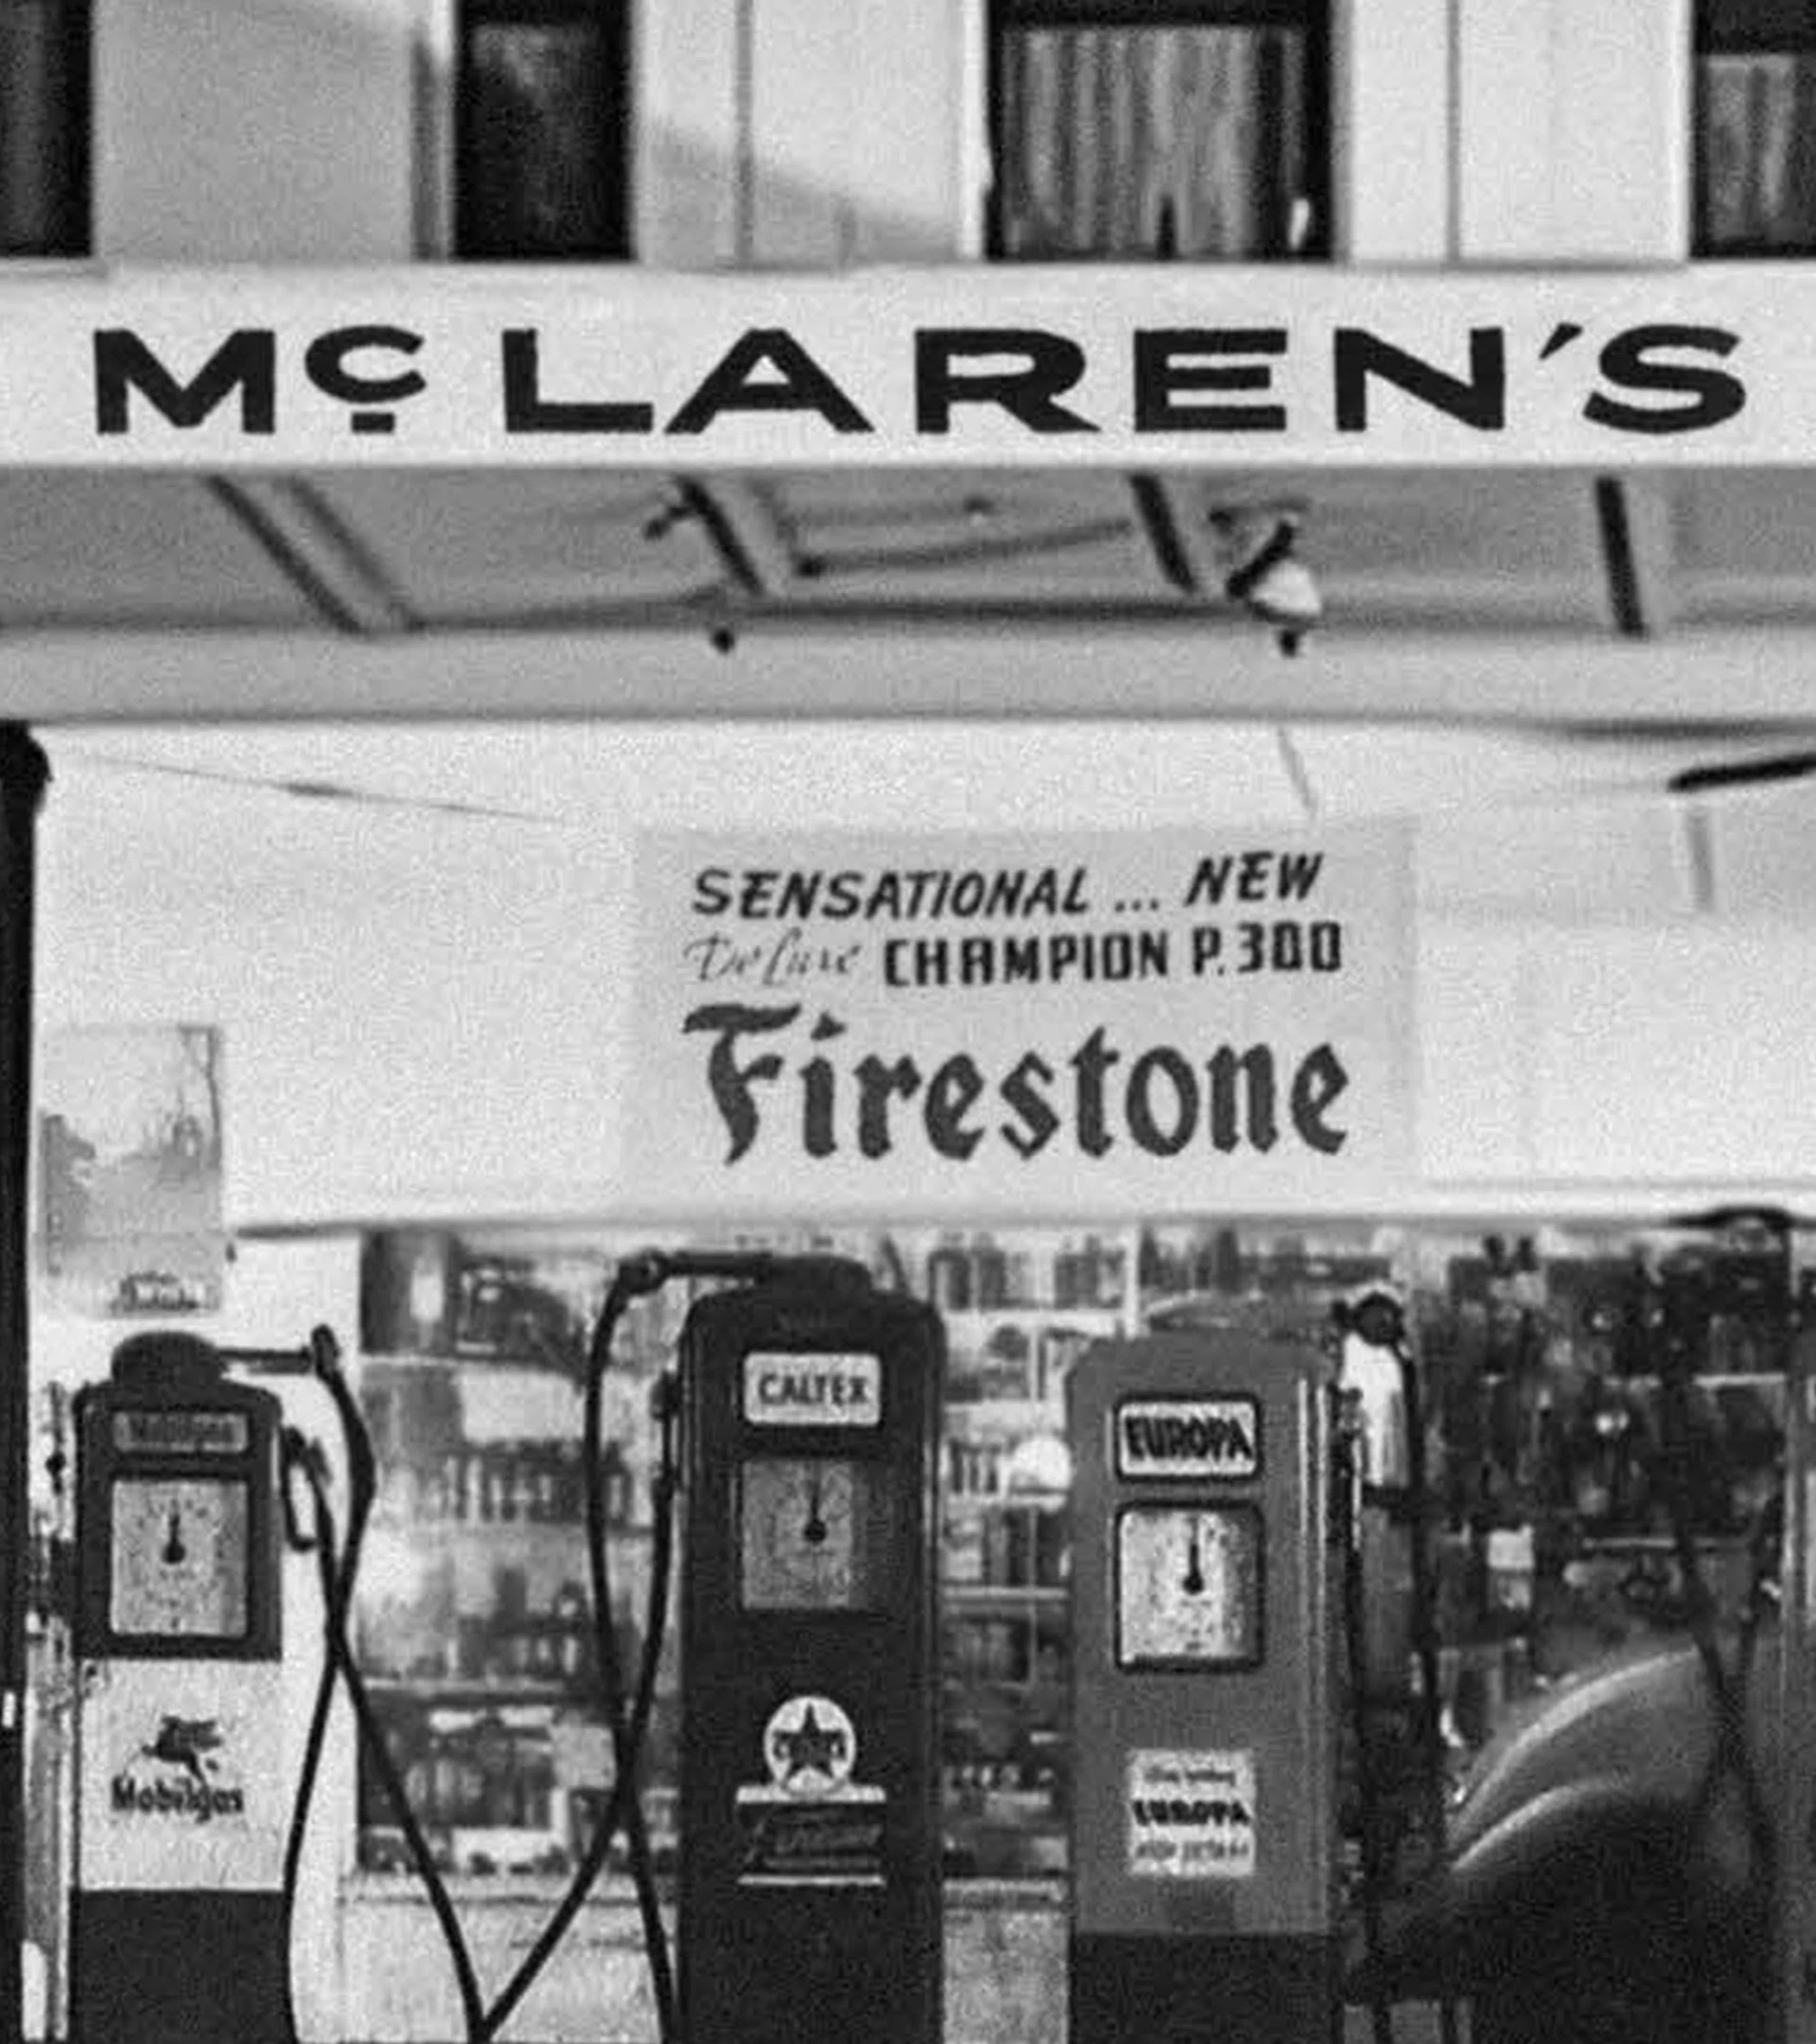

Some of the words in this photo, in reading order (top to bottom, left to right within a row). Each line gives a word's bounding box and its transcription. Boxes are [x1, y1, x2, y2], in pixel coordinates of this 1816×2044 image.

[692, 868, 1089, 920] SENSATIONAL
[1184, 850, 1324, 907] NEW
[884, 931, 1168, 987] CHAMPION
[682, 1003, 1348, 1164] Firestone
[758, 1373, 868, 1407] CALTEX
[1125, 1417, 1253, 1461] EUROPA
